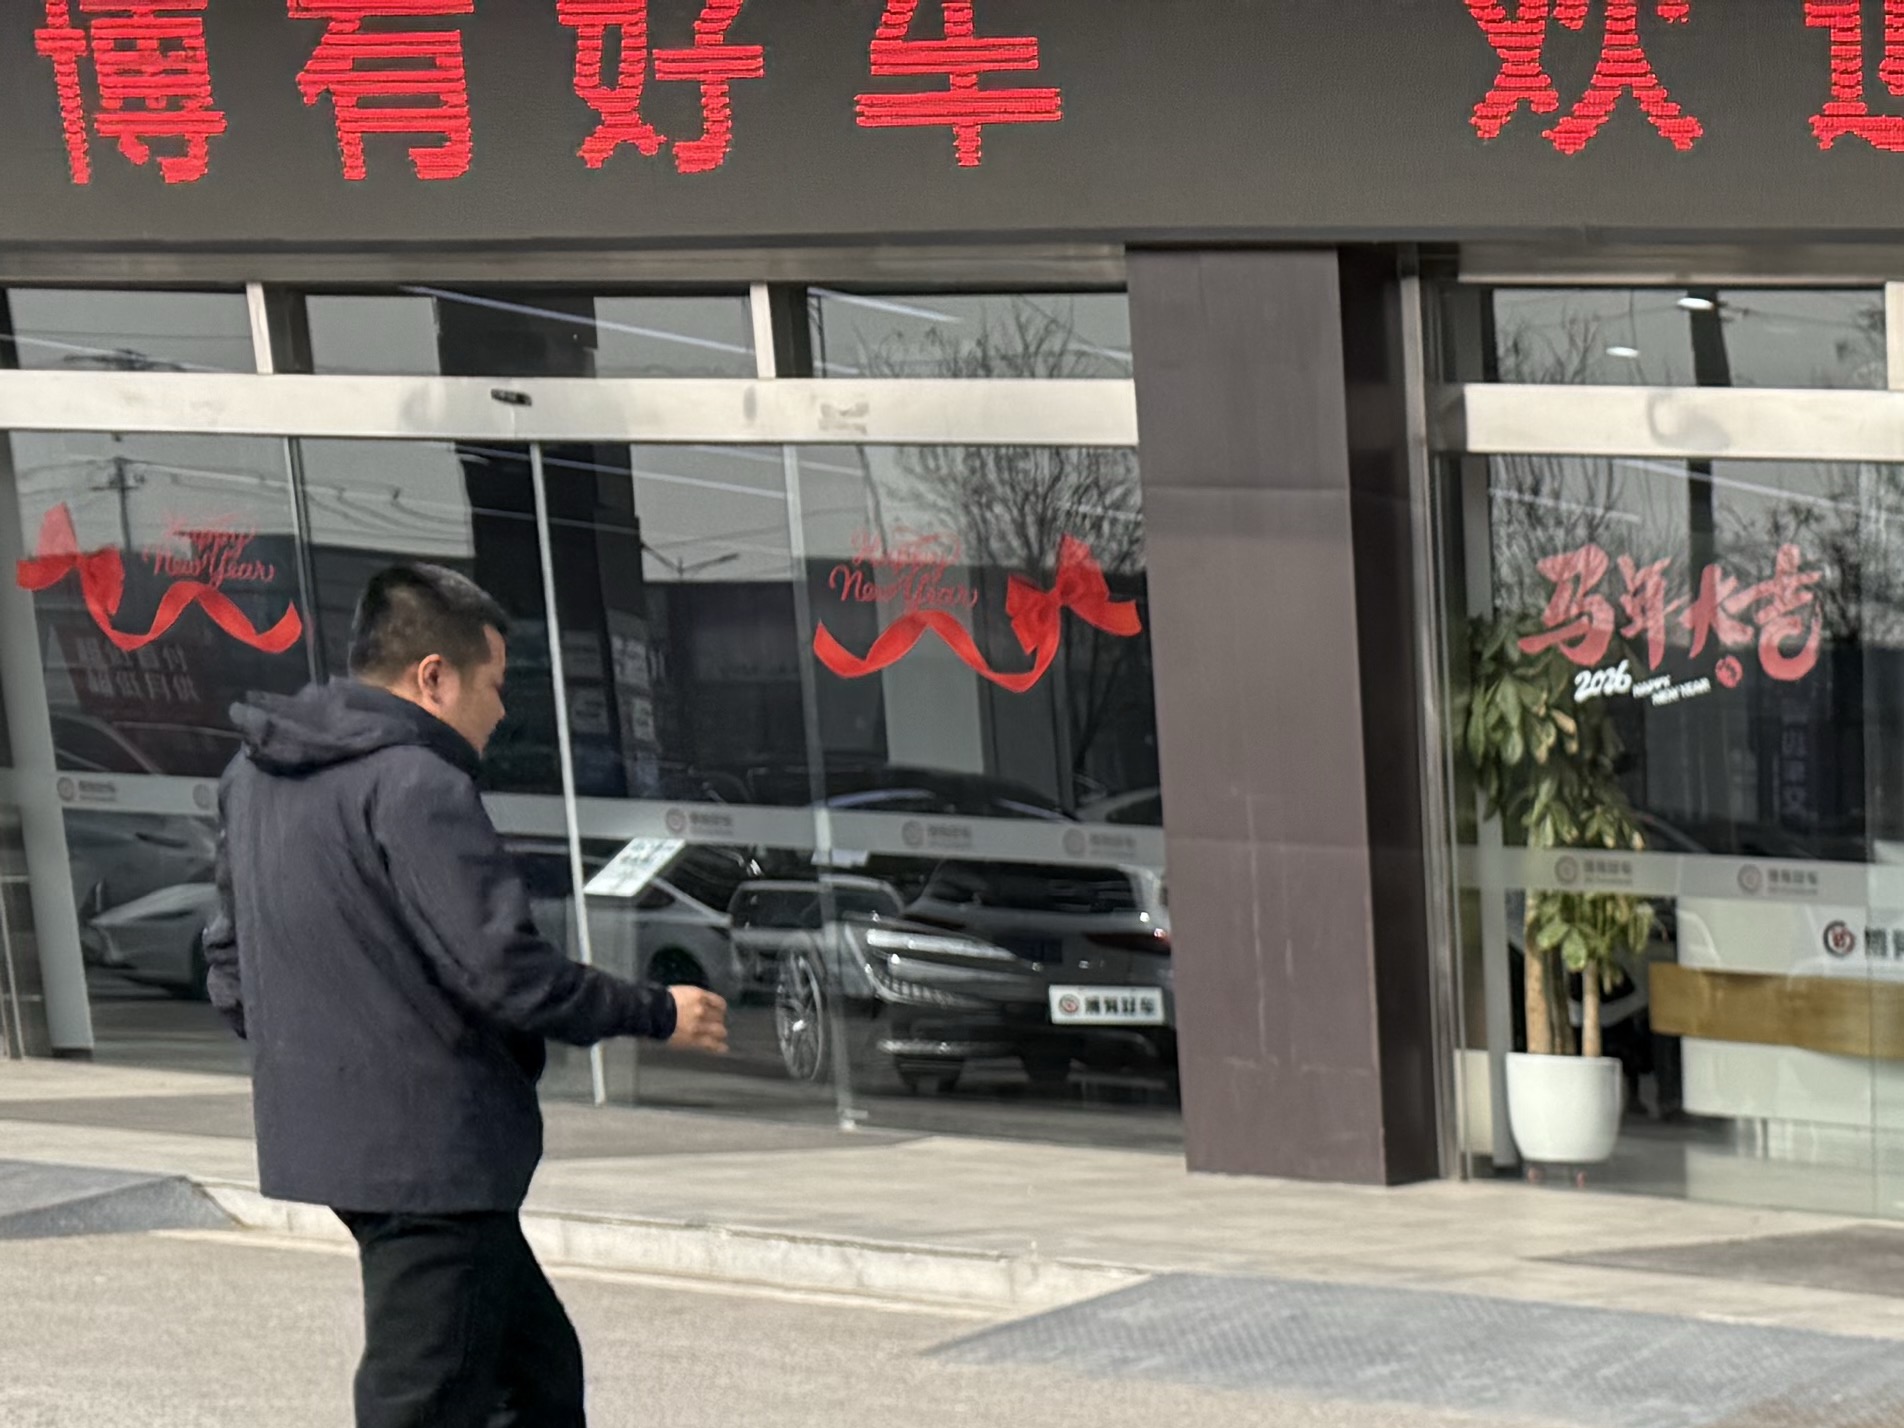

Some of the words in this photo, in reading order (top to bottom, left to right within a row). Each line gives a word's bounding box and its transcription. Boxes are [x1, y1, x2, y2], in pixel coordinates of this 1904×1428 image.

[206, 549, 277, 590] Year
[1518, 541, 1823, 682] 马年大吉
[1573, 659, 1633, 704] 2026
